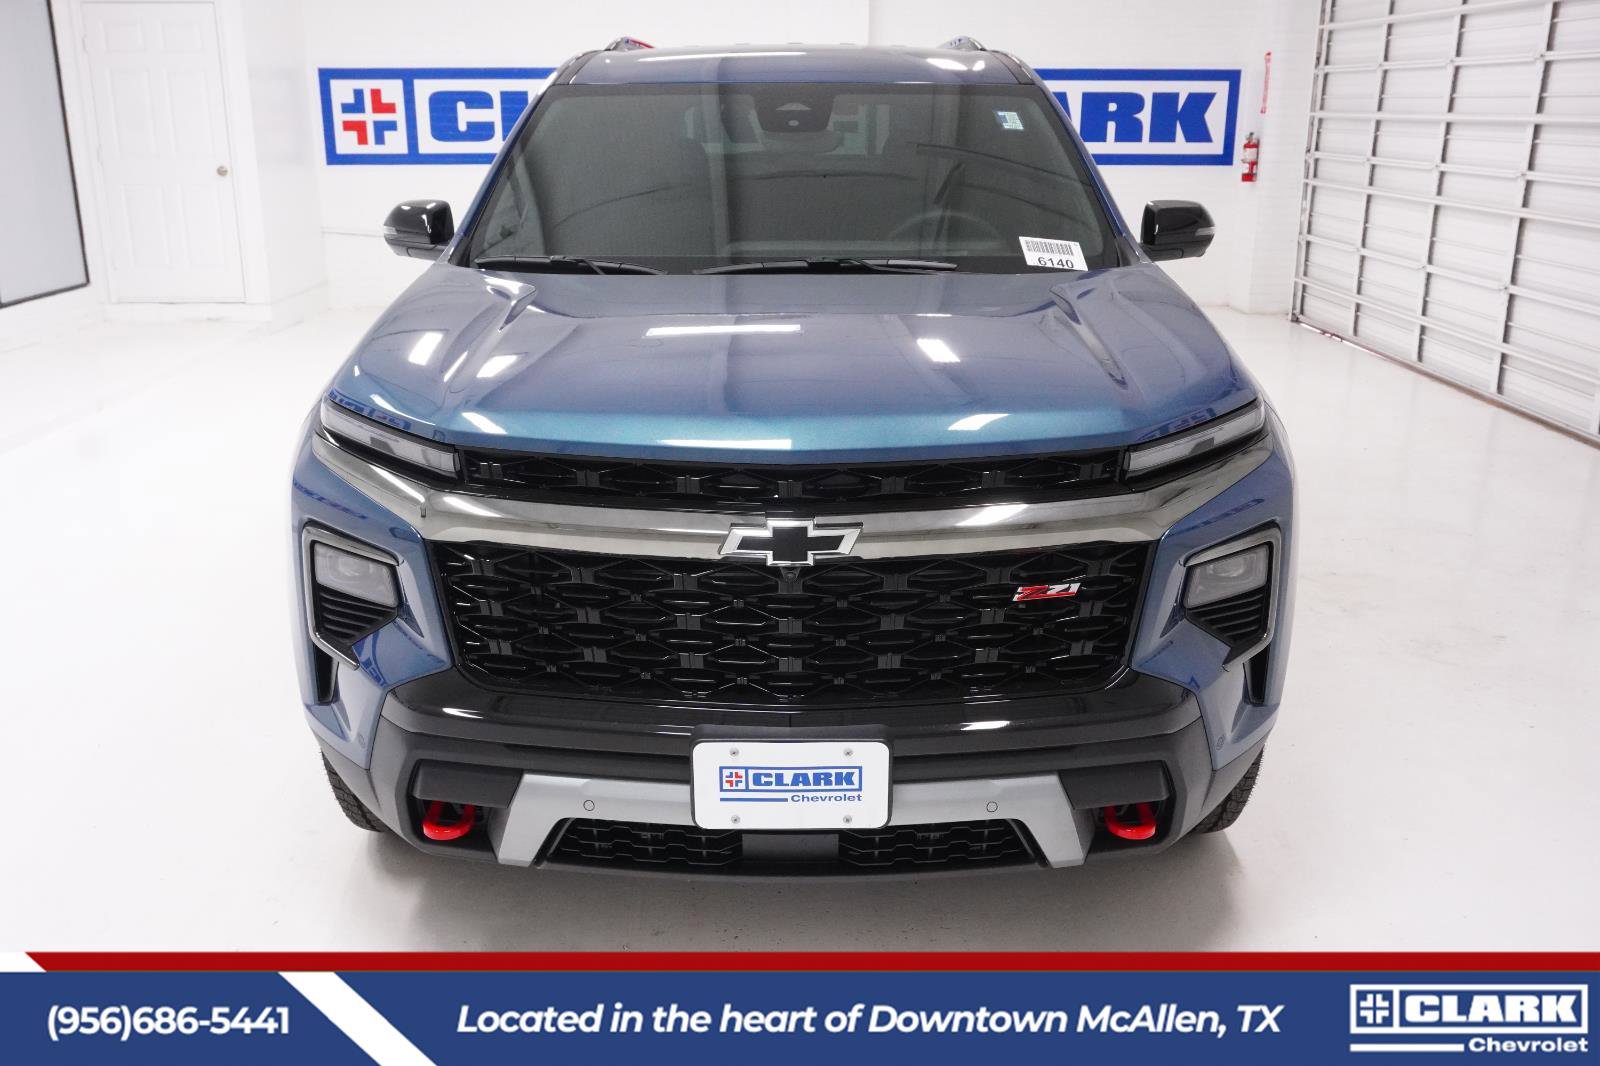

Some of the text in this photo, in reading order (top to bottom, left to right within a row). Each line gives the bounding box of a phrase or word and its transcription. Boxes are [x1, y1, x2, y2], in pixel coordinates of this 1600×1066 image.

[1037, 256, 1075, 269] 6140
[1012, 582, 1081, 602] Z71
[752, 772, 856, 787] CLARK
[790, 794, 863, 803] Chevrolet
